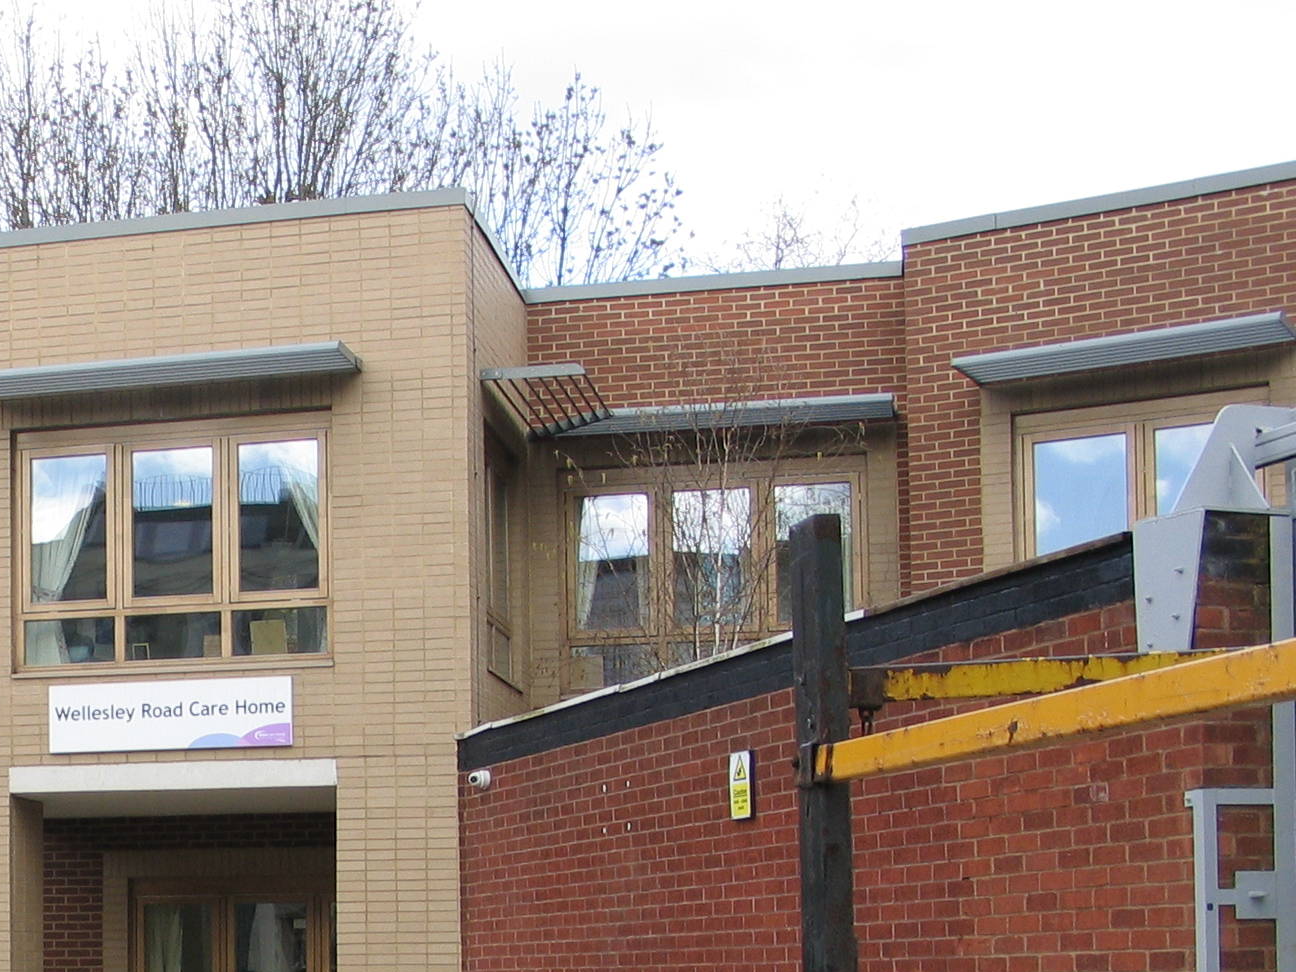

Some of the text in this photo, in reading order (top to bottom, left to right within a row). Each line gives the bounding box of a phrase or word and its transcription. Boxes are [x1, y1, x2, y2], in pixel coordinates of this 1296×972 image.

[54, 699, 286, 723] Wellesley Road Care Home
